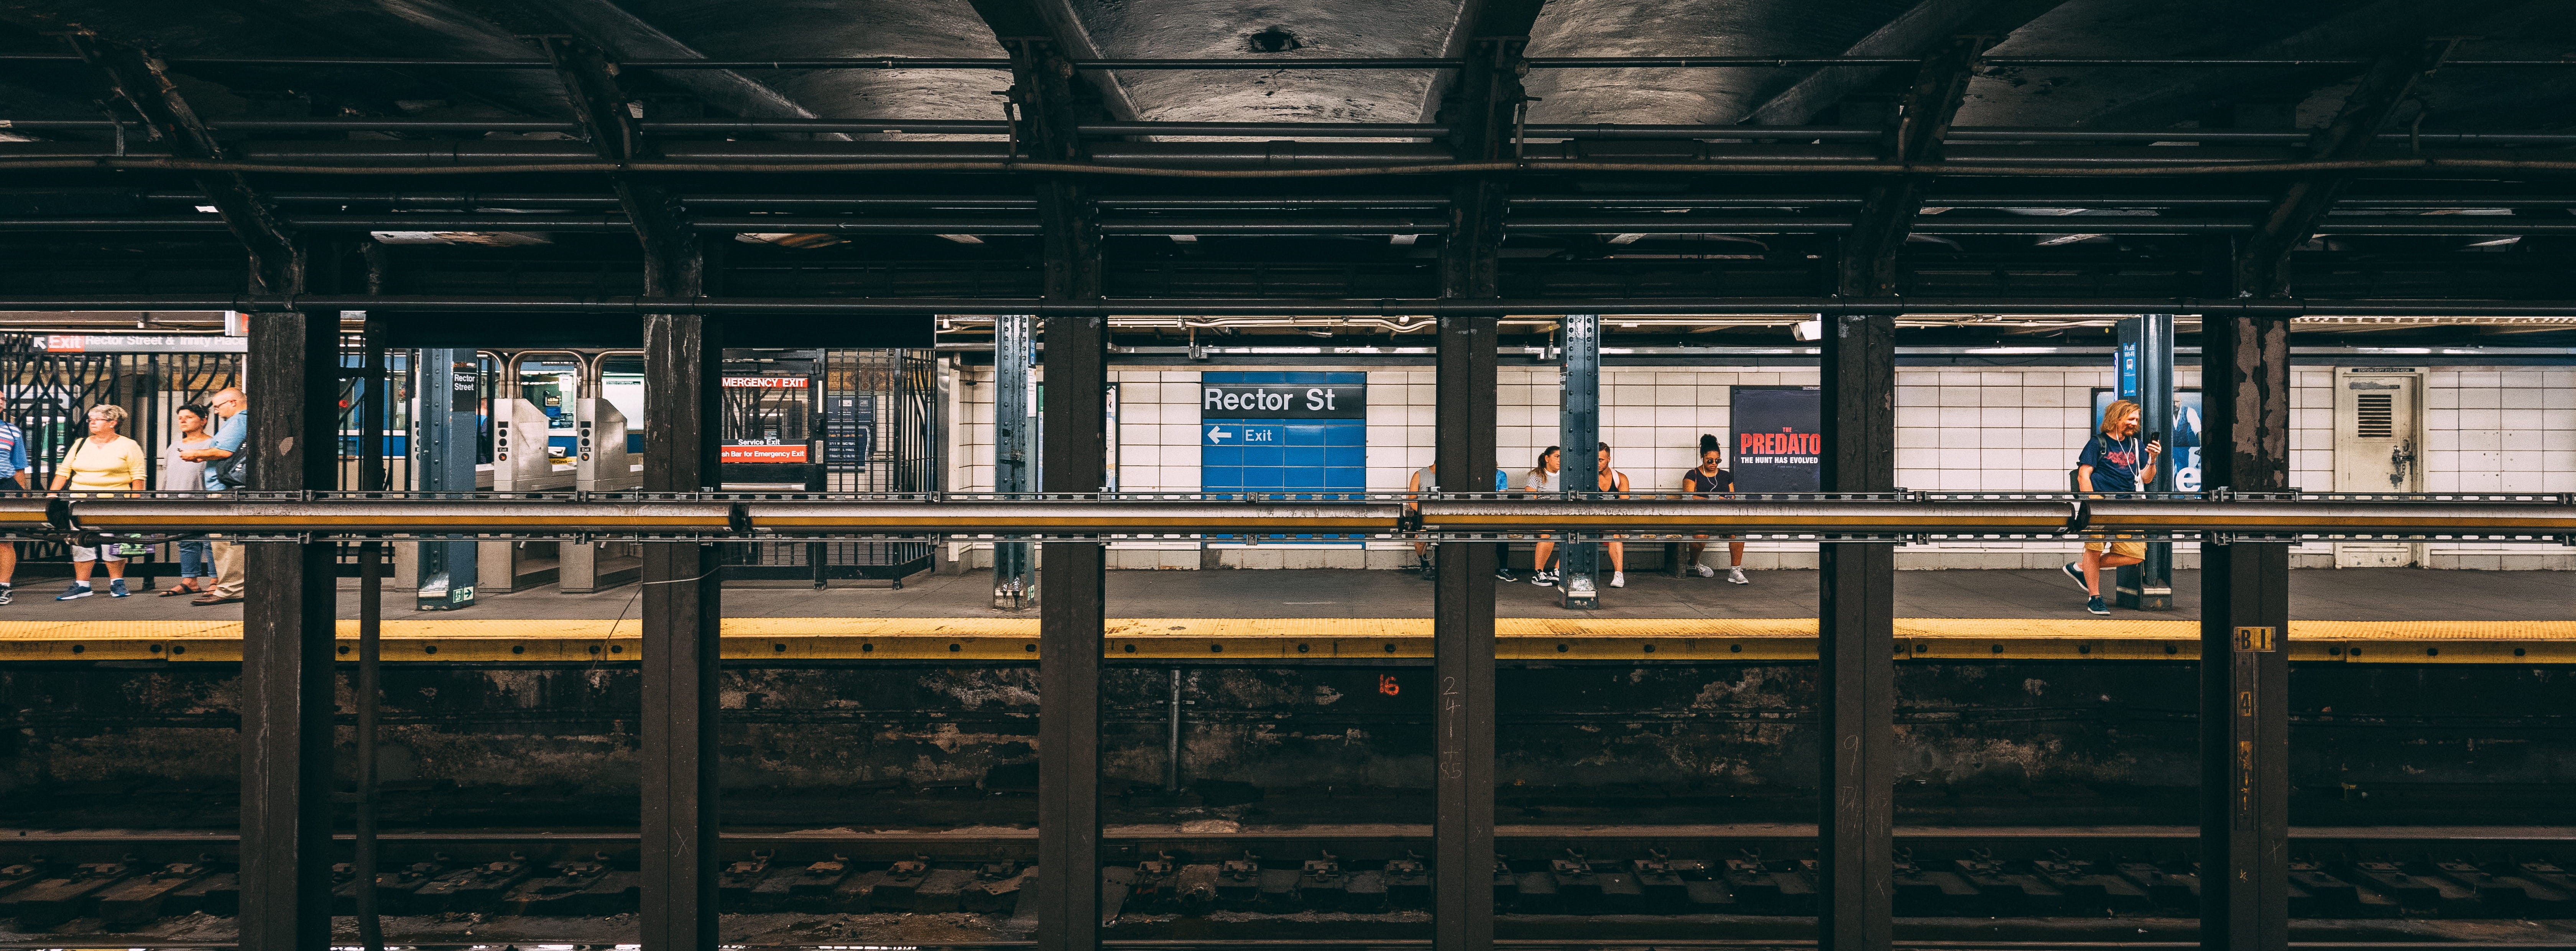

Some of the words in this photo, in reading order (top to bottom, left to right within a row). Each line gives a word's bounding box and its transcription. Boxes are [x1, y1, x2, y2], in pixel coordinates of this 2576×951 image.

[49, 335, 81, 348] Exit
[85, 336, 123, 345] Rector
[127, 336, 163, 345] Street
[166, 337, 174, 345] &
[722, 378, 778, 387] MERGENCY
[782, 379, 805, 387] EXIT
[1205, 388, 1293, 410] Rector
[1306, 388, 1335, 410] St
[1245, 429, 1272, 441] Exit
[1741, 434, 1820, 455] PREDATO
[1380, 674, 1399, 695] 16
